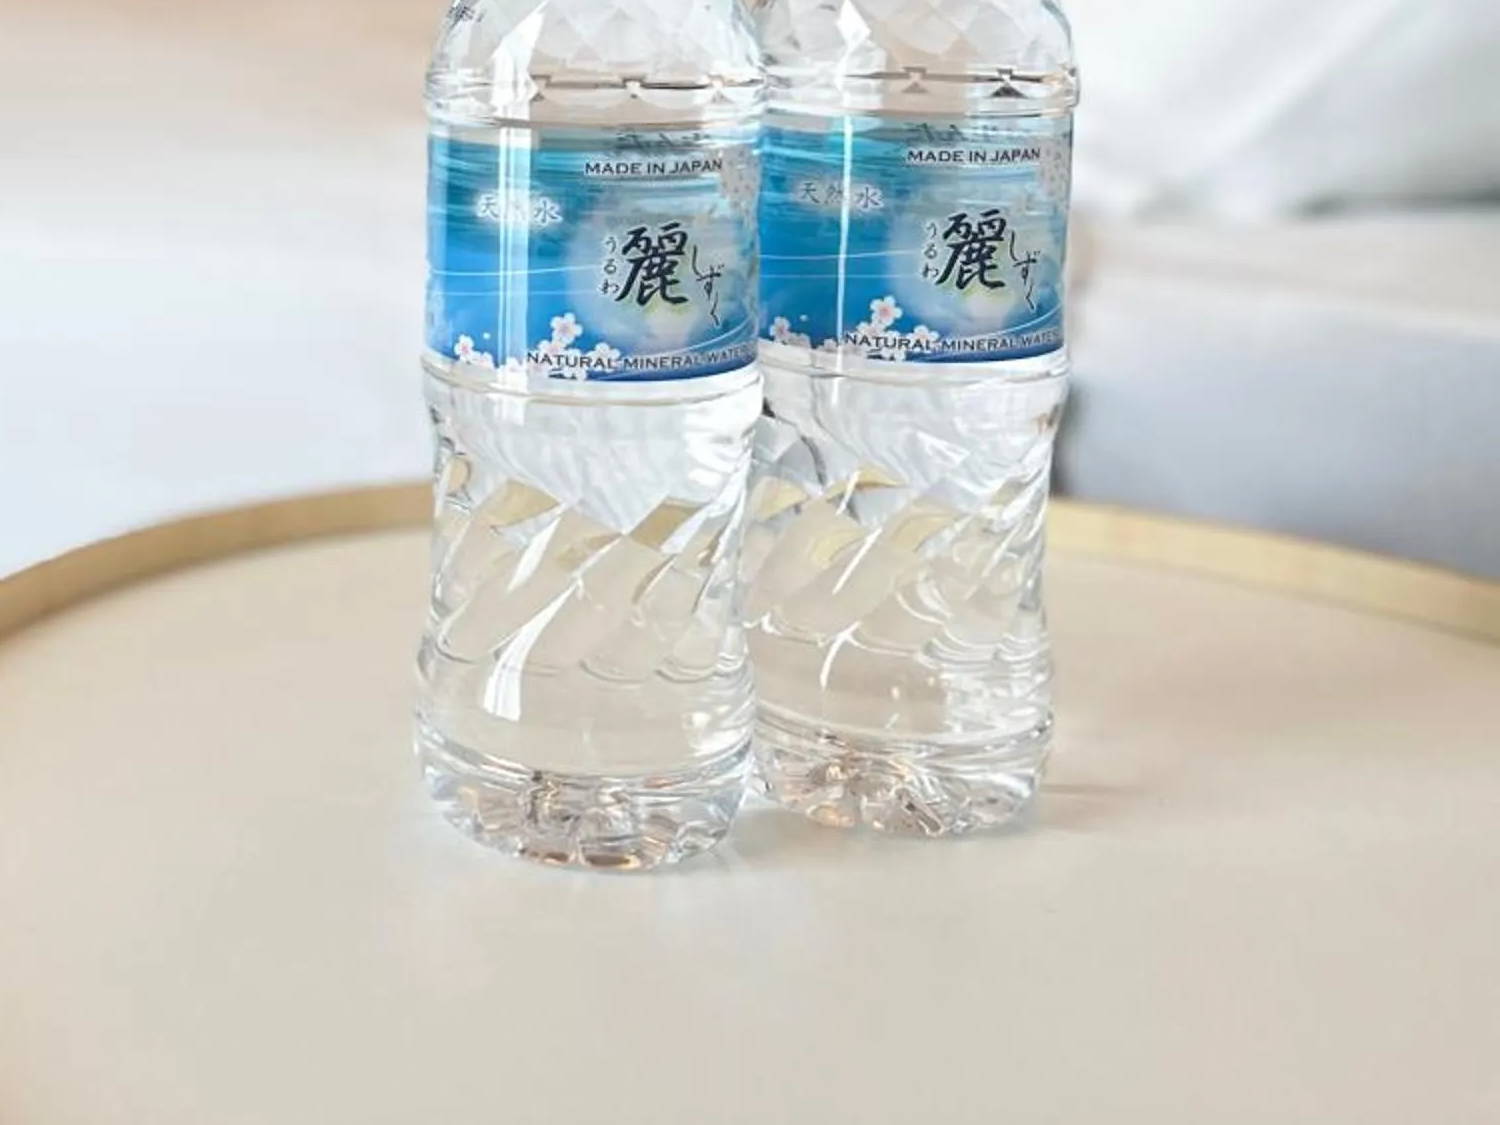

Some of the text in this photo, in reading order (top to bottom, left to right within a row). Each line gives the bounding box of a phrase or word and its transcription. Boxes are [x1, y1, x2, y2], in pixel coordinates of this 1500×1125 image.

[908, 146, 1041, 163] MADE IN JAPAN
[584, 158, 723, 175] MADE IN JAPAN
[480, 195, 560, 224] 天水
[935, 209, 1006, 290] 麗
[615, 222, 688, 306] 麗
[844, 332, 936, 351] NATURAL
[941, 336, 1017, 352] MINERAL
[527, 351, 618, 370] NATURAL
[623, 353, 703, 370] MINERAL
